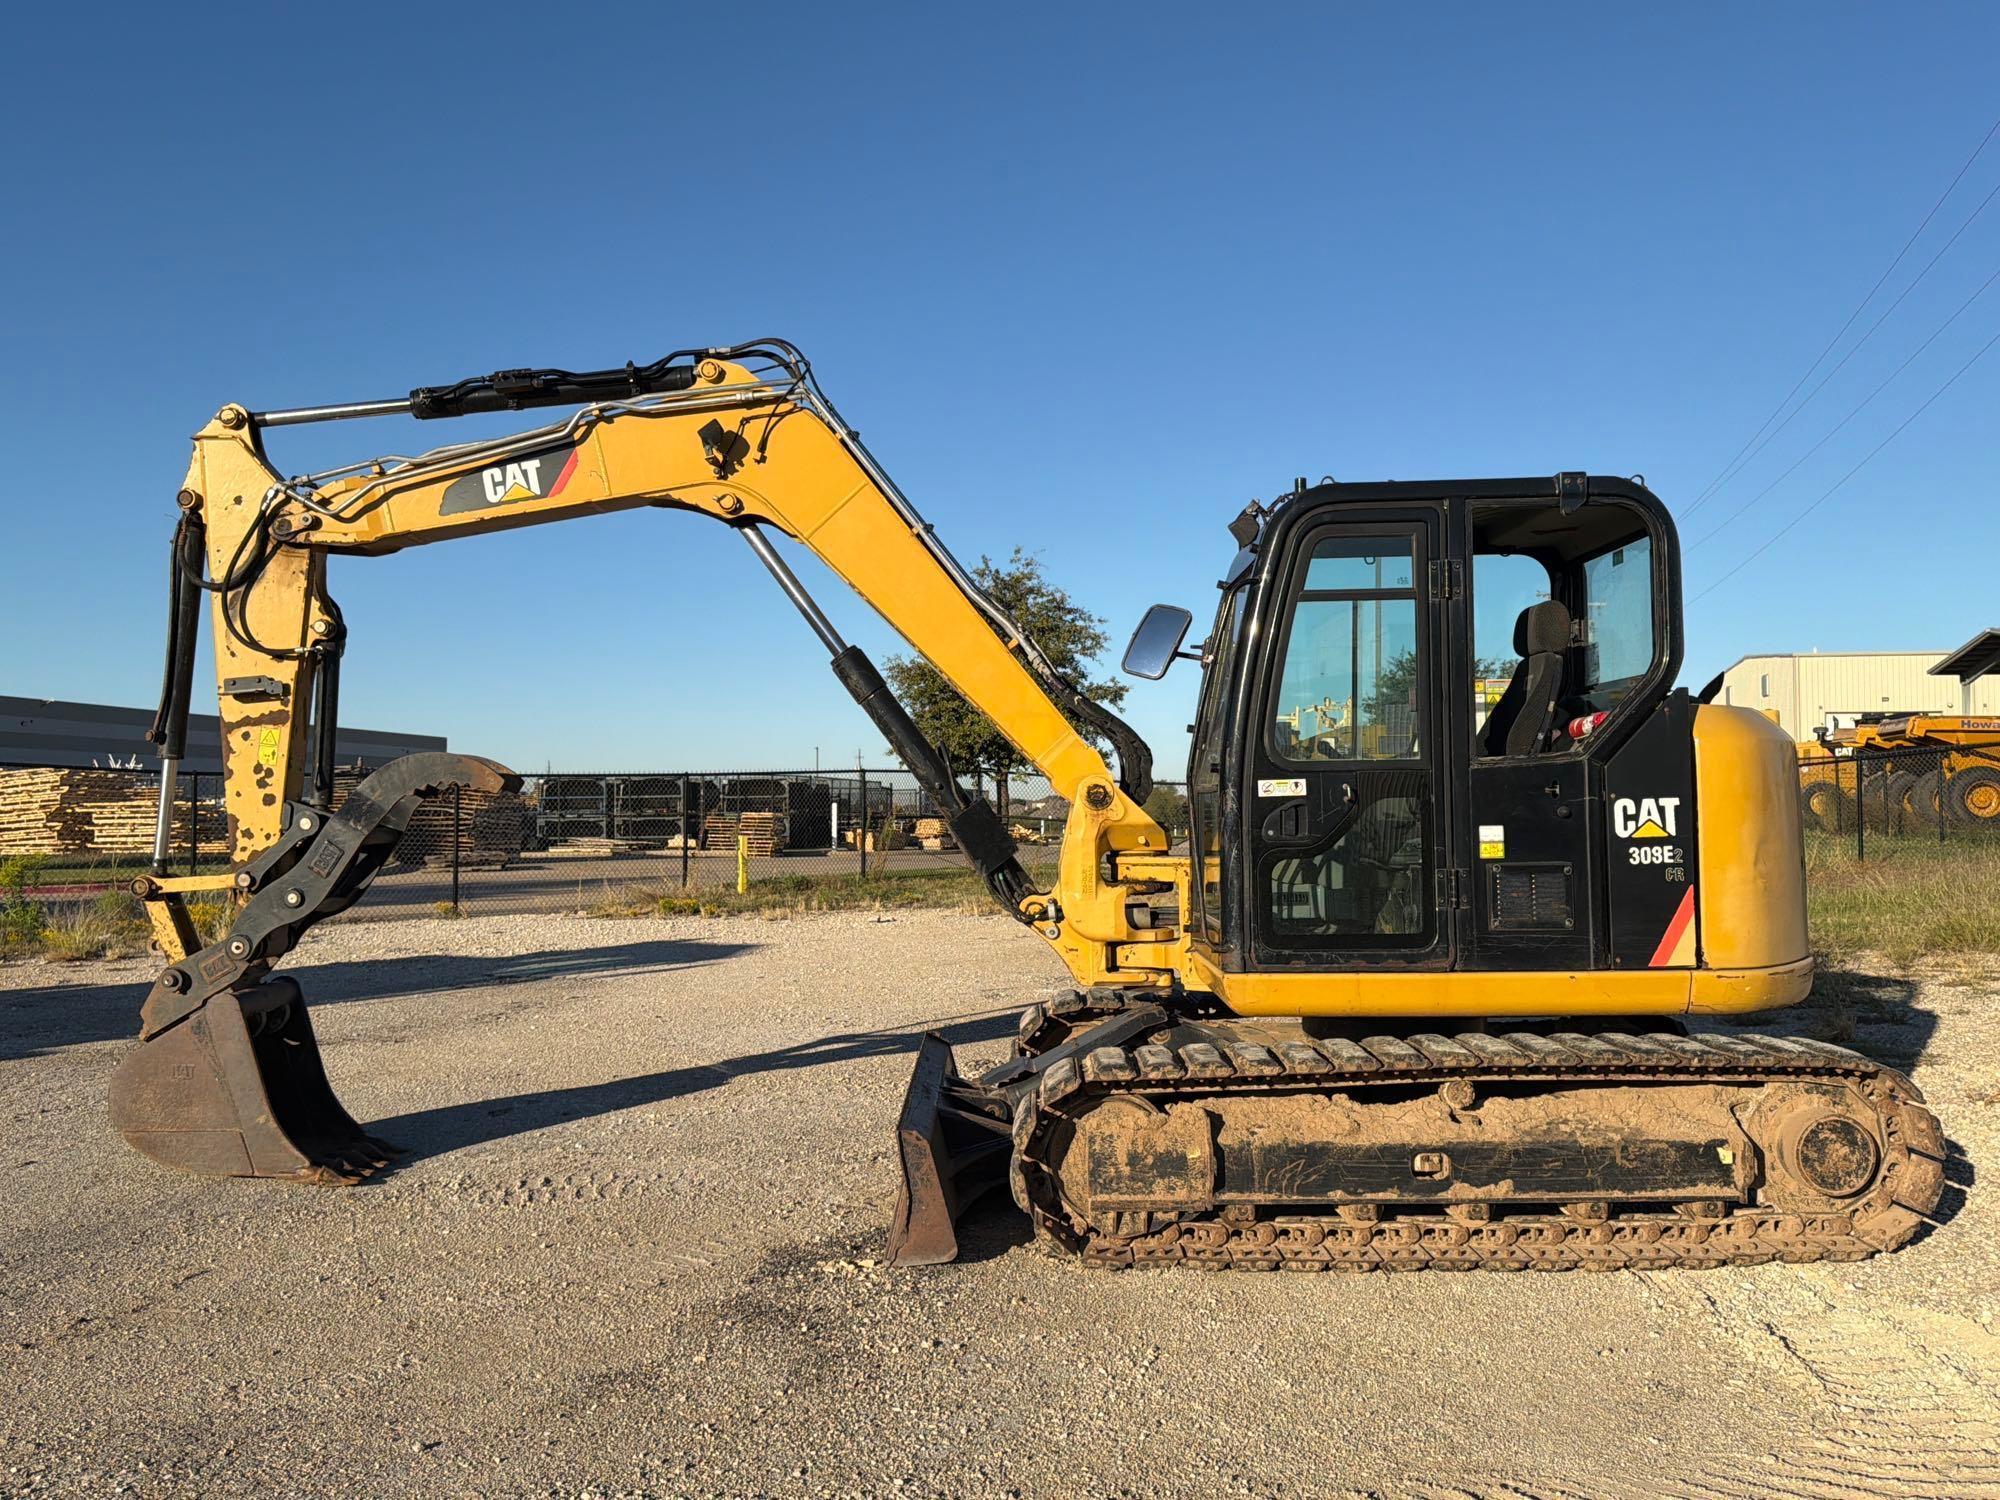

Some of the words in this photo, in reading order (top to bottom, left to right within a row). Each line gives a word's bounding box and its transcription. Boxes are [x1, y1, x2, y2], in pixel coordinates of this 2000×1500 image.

[482, 459, 541, 503] CAT
[1834, 746, 1854, 757] CAT
[1613, 797, 1681, 838] CAT
[1665, 867, 1685, 881] CR
